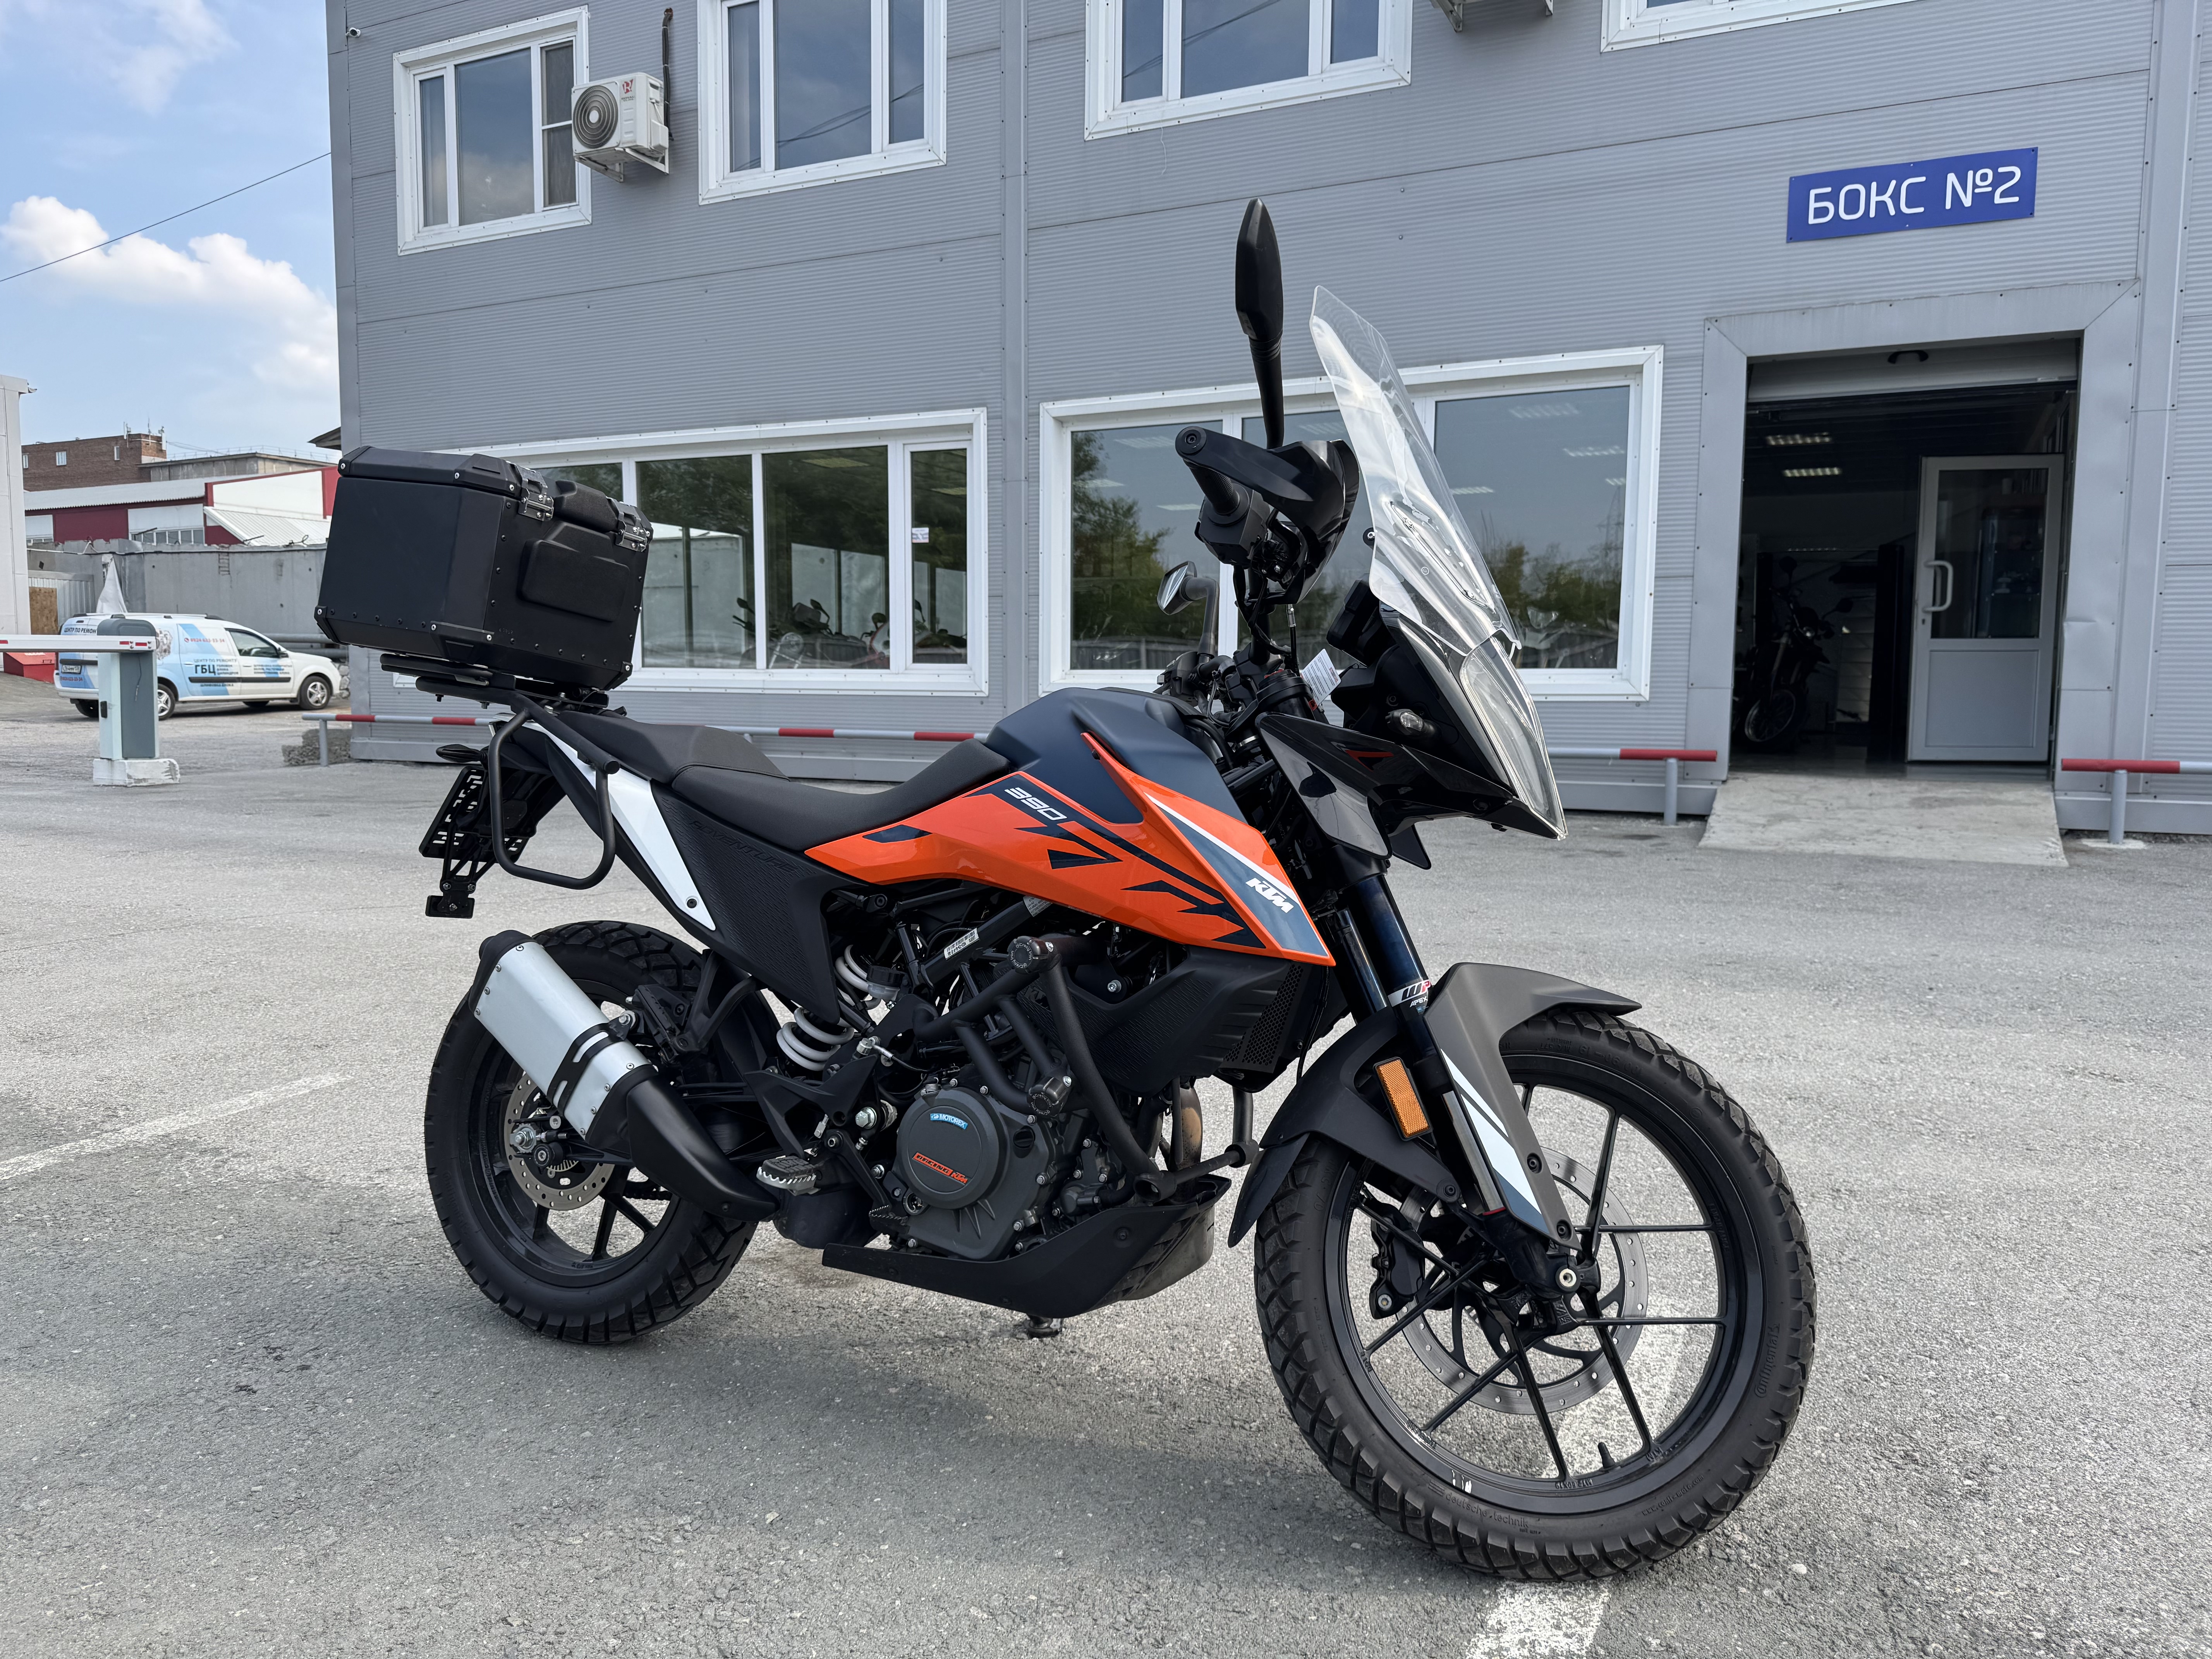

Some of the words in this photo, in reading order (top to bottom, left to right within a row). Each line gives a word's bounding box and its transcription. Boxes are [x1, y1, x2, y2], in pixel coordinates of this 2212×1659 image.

[1808, 176, 1926, 225] БОКС
[1945, 166, 2021, 210] №2
[195, 665, 216, 675] ГБЦ
[1004, 787, 1067, 820] 390
[1245, 878, 1294, 913] KTM
[1401, 981, 1430, 1001] WP
[1410, 996, 1428, 1007] APEX
[939, 1114, 965, 1128] MOTOREX
[916, 1154, 950, 1174] RACING
[951, 1172, 968, 1183] KTM
[1646, 1446, 1664, 1462] KTM
[1446, 1492, 1487, 1517] deutsche
[1493, 1510, 1529, 1528] technik
